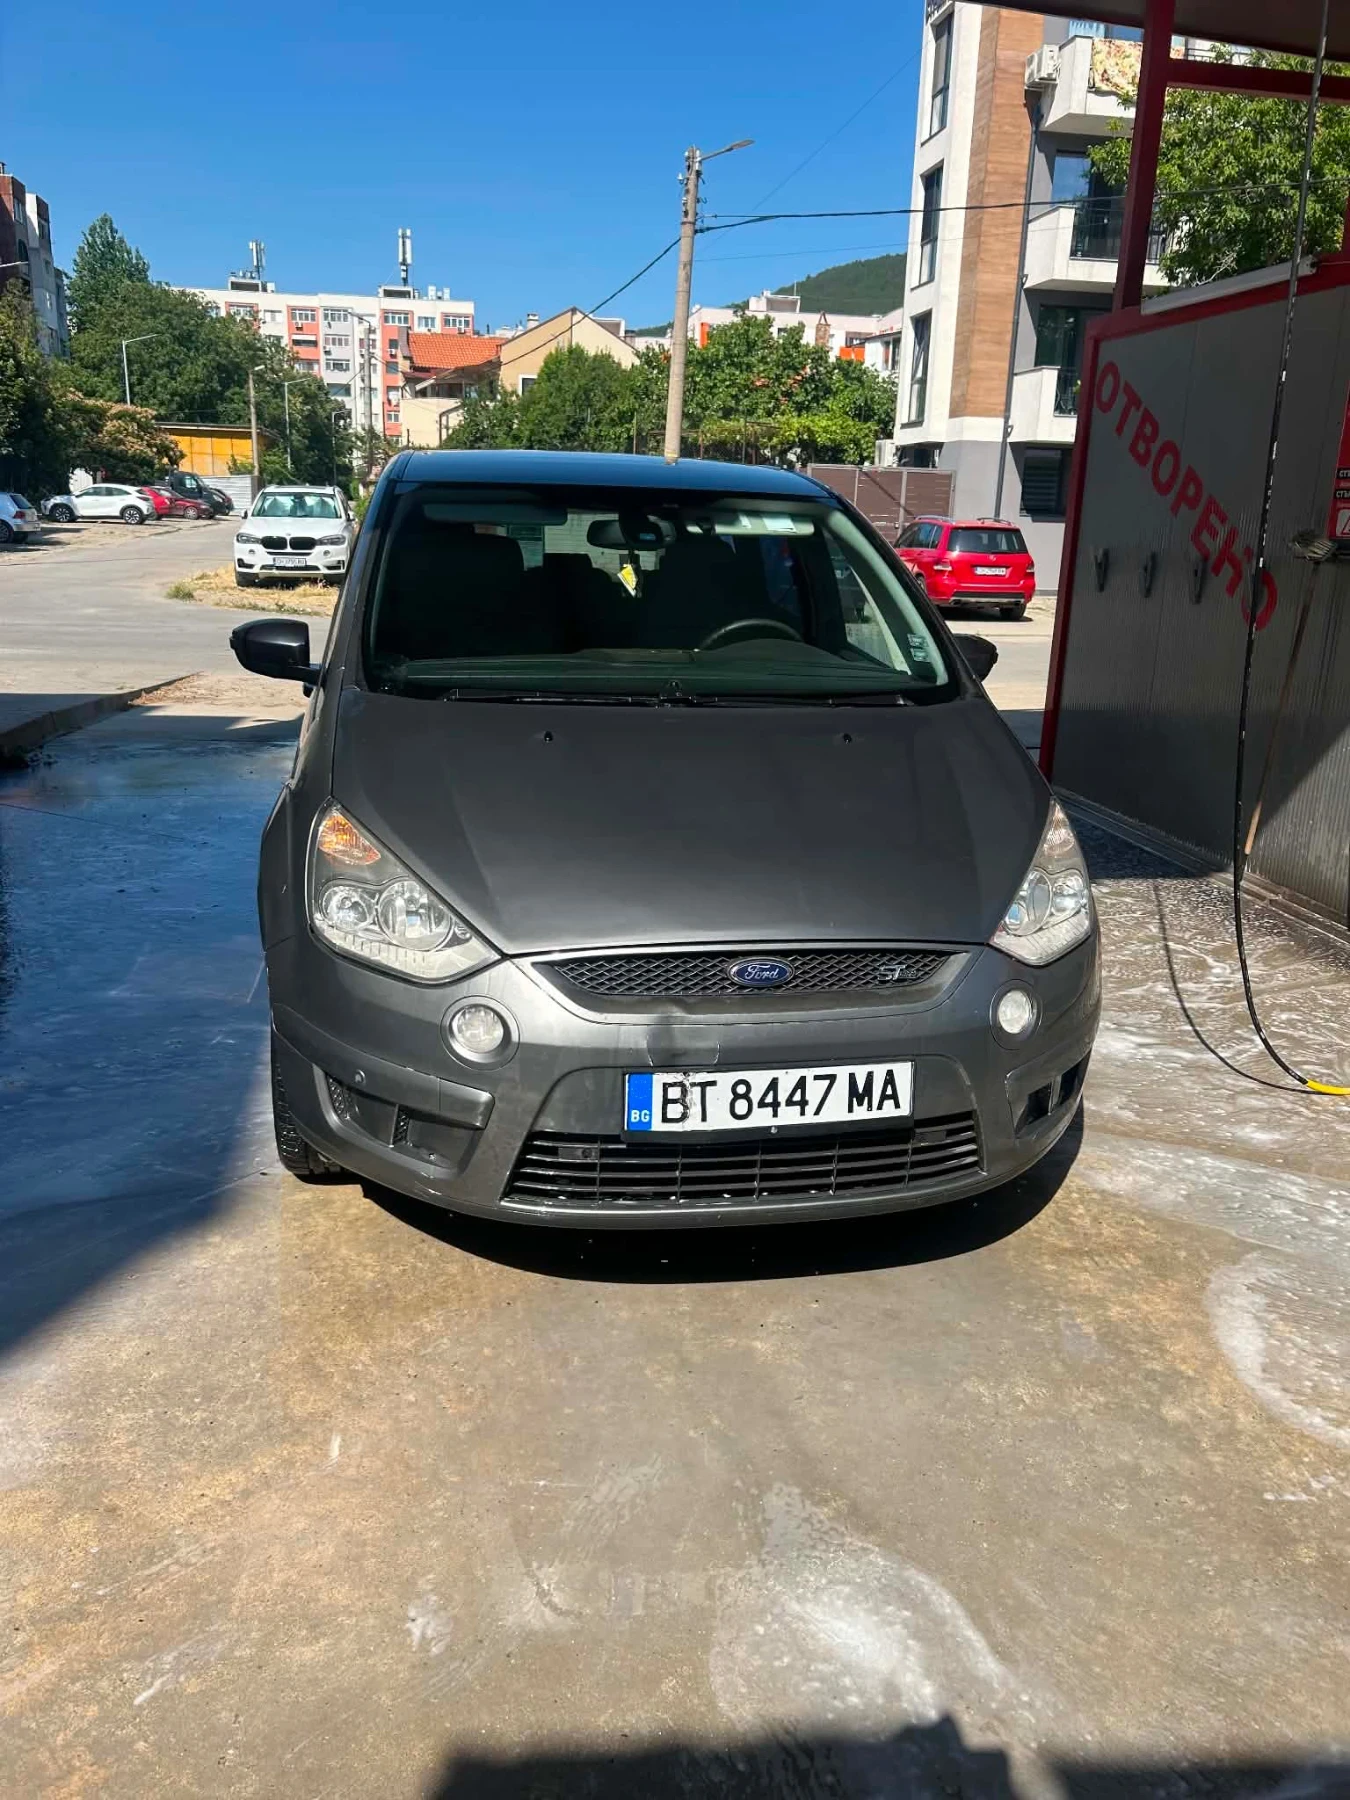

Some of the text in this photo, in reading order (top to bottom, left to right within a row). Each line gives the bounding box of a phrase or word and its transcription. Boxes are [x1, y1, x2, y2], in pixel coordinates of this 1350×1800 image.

[1095, 361, 1278, 632] ОТВОРЕНО
[745, 964, 780, 980] Ford
[661, 1069, 901, 1124] BT 8447 MA
[630, 1110, 650, 1123] BG
